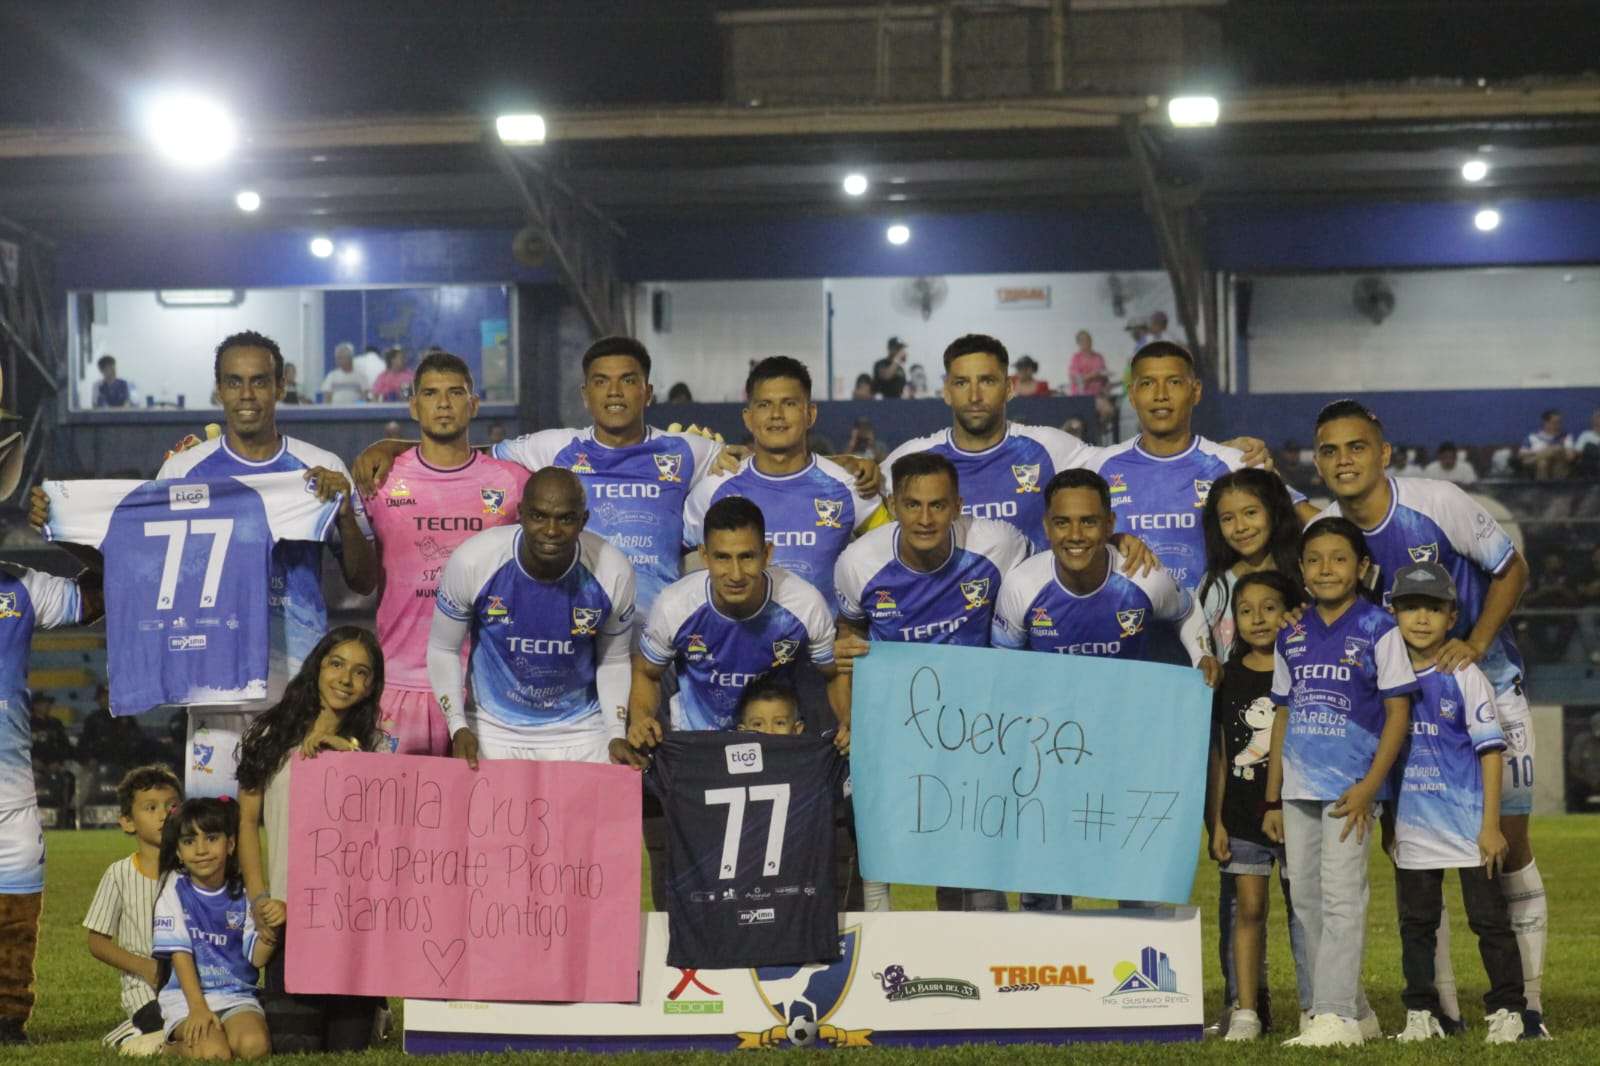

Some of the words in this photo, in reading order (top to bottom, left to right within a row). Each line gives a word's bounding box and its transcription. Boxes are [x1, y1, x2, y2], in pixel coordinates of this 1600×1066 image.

[176, 490, 204, 504] tigo
[591, 483, 661, 498] TECNO
[385, 498, 417, 507] TRIGAL
[960, 501, 1017, 519] ECNO
[413, 516, 483, 531] TECNO
[1127, 512, 1196, 530] TECNO
[764, 531, 816, 546] CNO
[144, 518, 234, 610] 77
[415, 588, 438, 598] MUN
[1054, 641, 1121, 655] TECNO
[710, 669, 757, 688] TECN
[1293, 664, 1351, 681] TECNO
[1290, 708, 1347, 726] STARBUS
[1508, 754, 1534, 789] 10
[323, 766, 442, 830] Camila
[467, 776, 550, 857] Cruz
[909, 774, 1046, 843] Dilan
[704, 783, 791, 880] 77
[502, 844, 603, 900] Pronto
[303, 885, 432, 933] Estamos
[468, 888, 568, 951] Contigo
[990, 965, 1095, 986] TRIGAL
[905, 985, 916, 995] LA
[945, 984, 960, 993] DEL
[1121, 997, 1163, 1005] GUSTAVO
